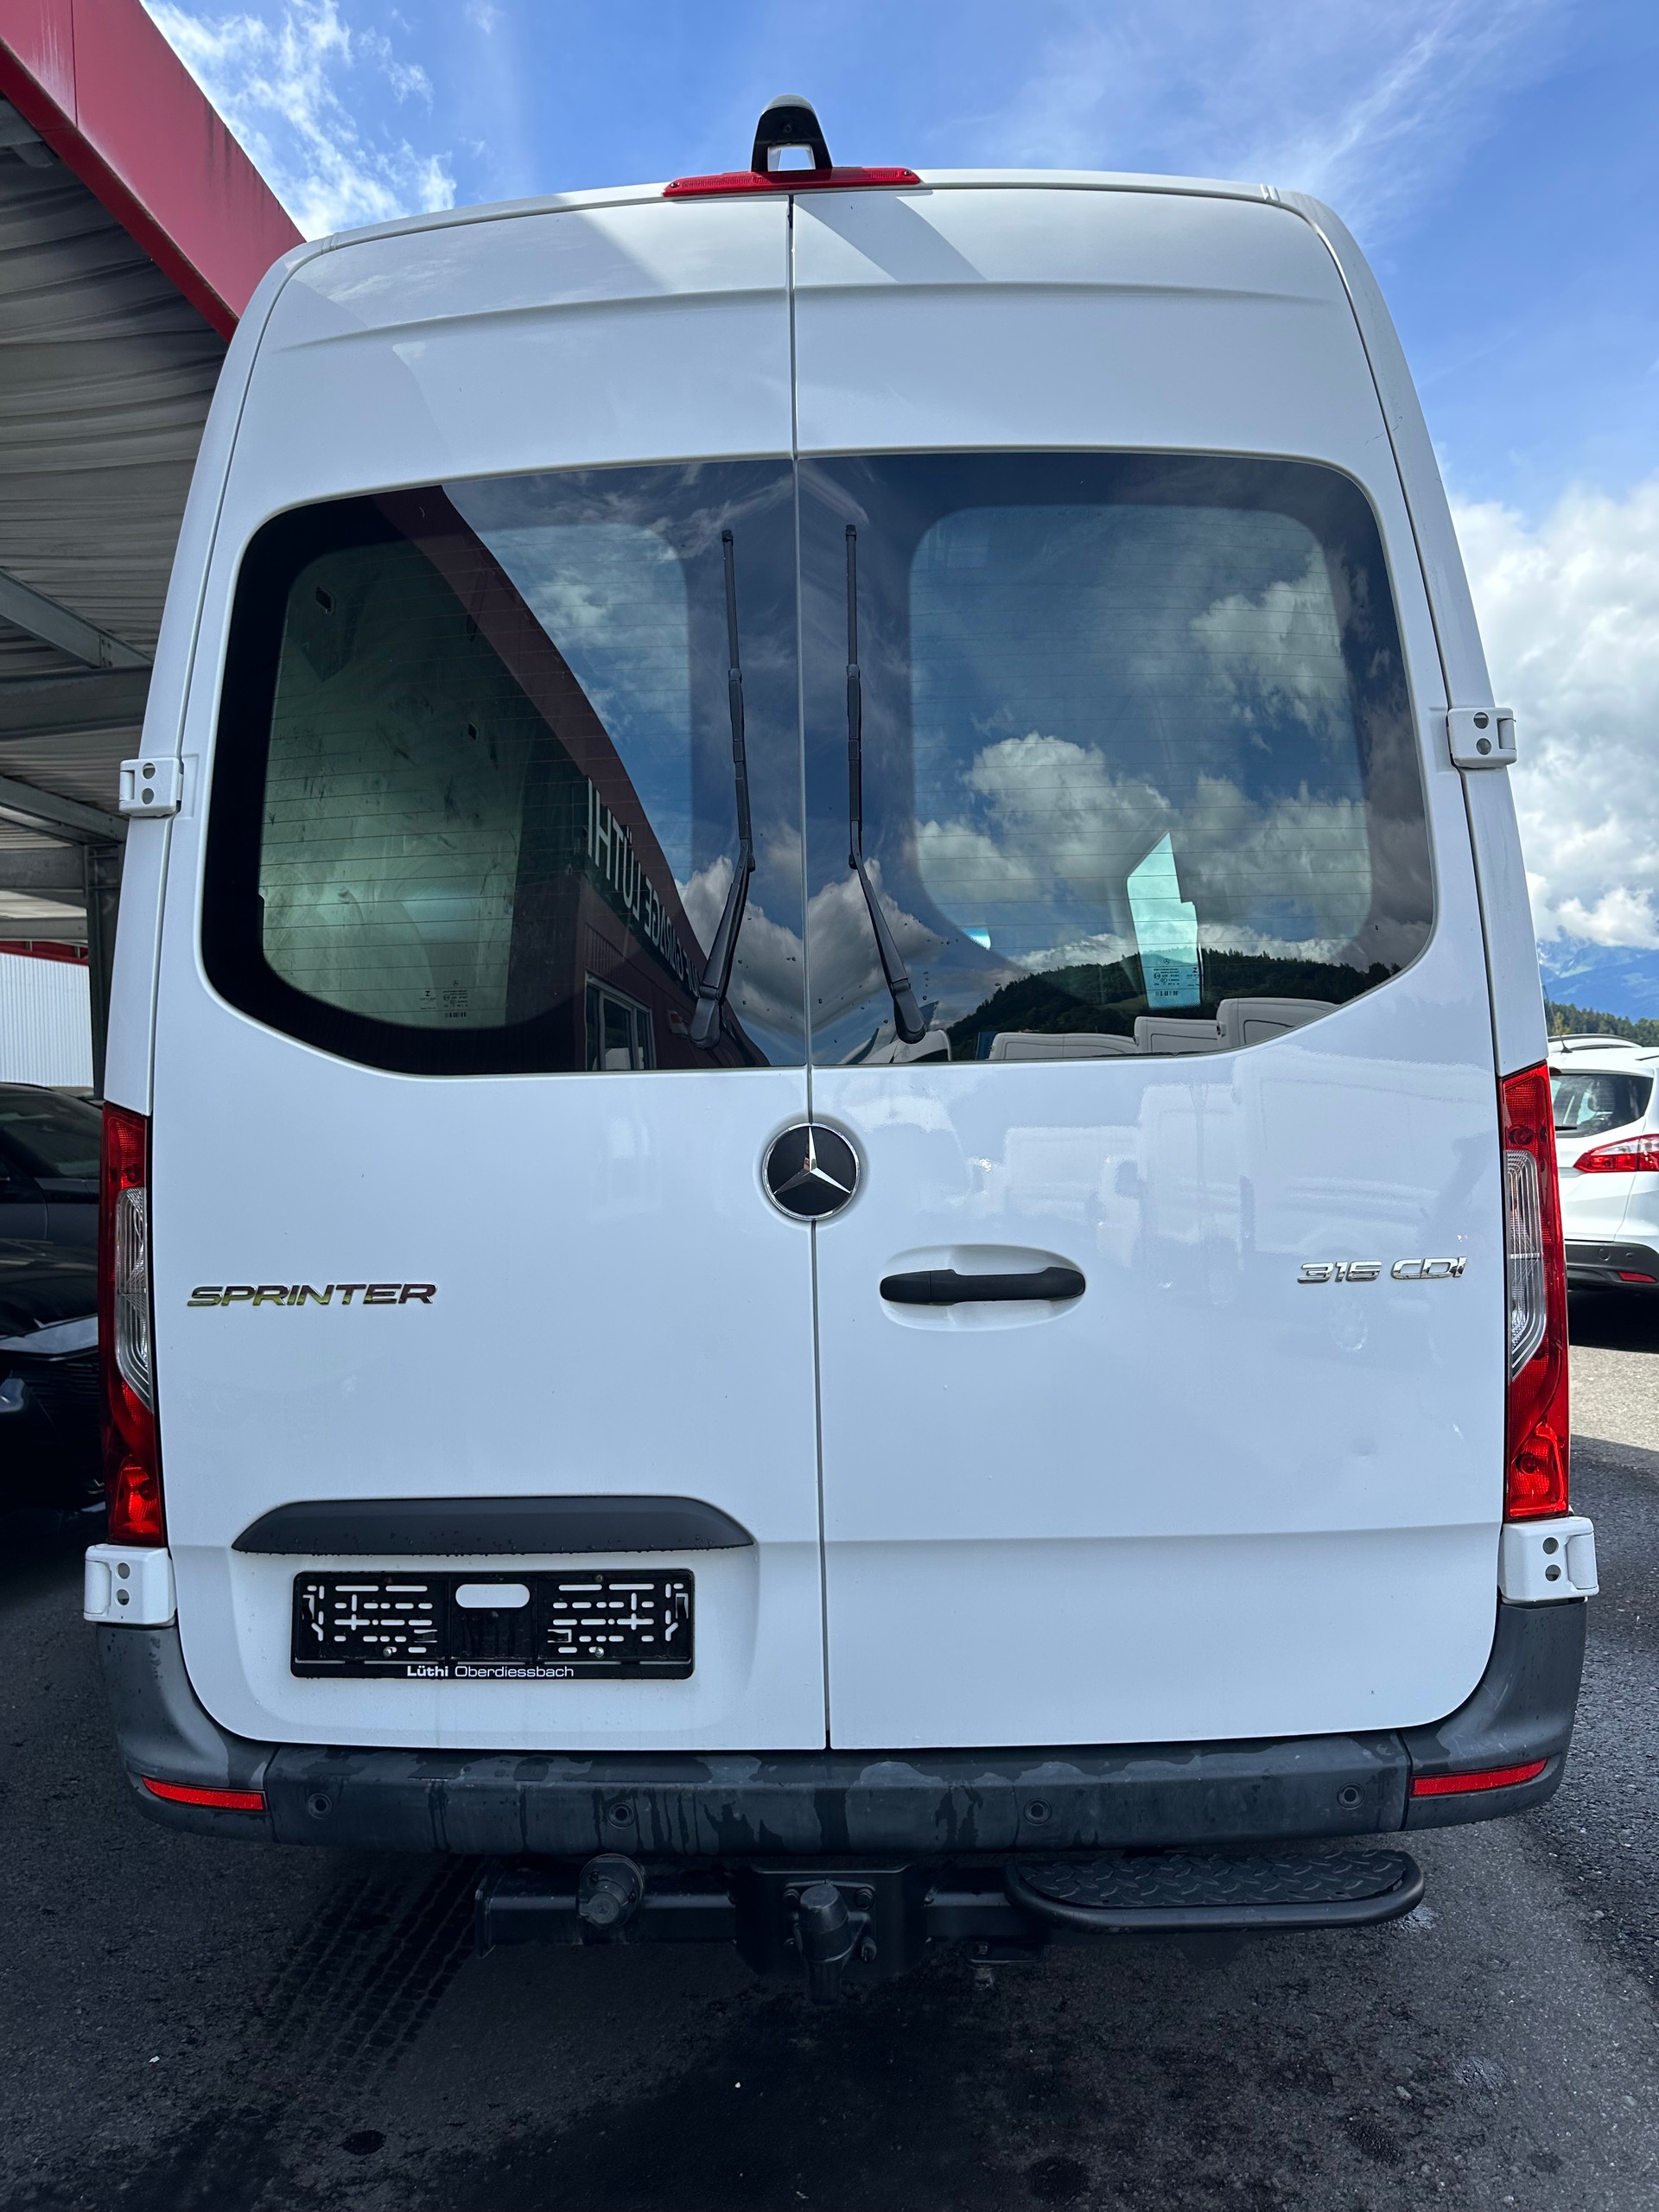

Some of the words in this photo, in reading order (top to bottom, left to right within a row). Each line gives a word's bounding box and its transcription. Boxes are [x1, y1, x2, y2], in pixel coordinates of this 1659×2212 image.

[1297, 1261, 1382, 1284] 316
[1390, 1256, 1467, 1280] CDI
[187, 1282, 439, 1306] SPRINTER
[406, 1665, 449, 1677] Lüthi
[454, 1665, 575, 1677] Oberdiessbach
